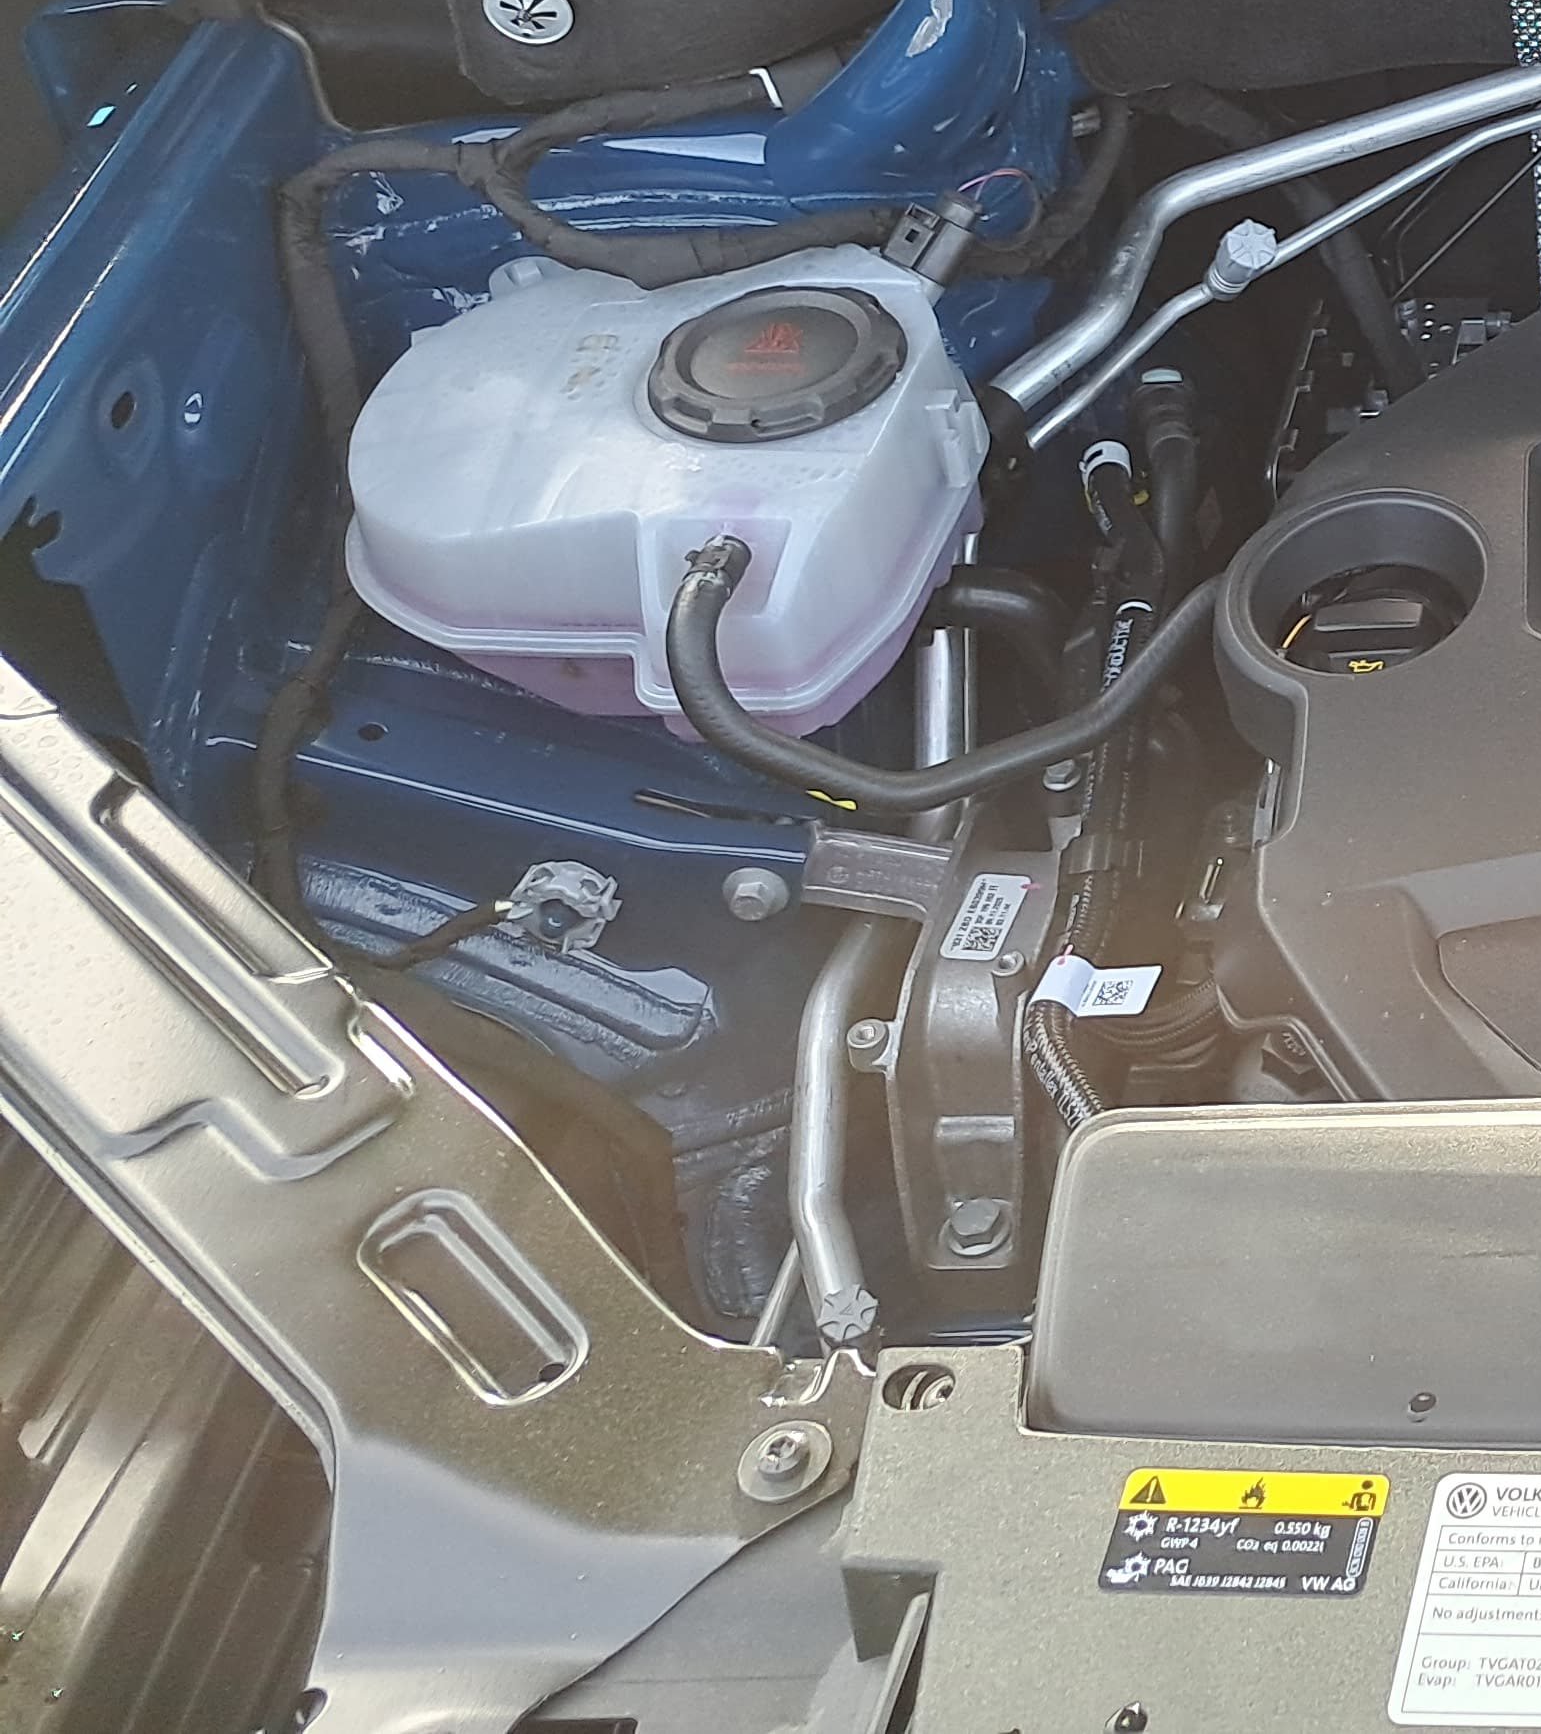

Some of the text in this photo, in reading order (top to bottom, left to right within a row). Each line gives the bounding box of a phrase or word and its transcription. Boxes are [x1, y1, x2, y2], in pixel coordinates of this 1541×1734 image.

[1166, 1517, 1331, 1538] R-1234yf 0.550 kg
[1449, 1533, 1516, 1546] Conforms
[1521, 1535, 1534, 1546] to
[1264, 1541, 1278, 1553] eq
[1153, 1559, 1189, 1573] PAG
[1444, 1556, 1468, 1567] U.S.
[1302, 1577, 1355, 1591] VW AG
[1433, 1607, 1452, 1620] No
[1421, 1656, 1471, 1672] Group:
[1418, 1673, 1456, 1689] Evap:
